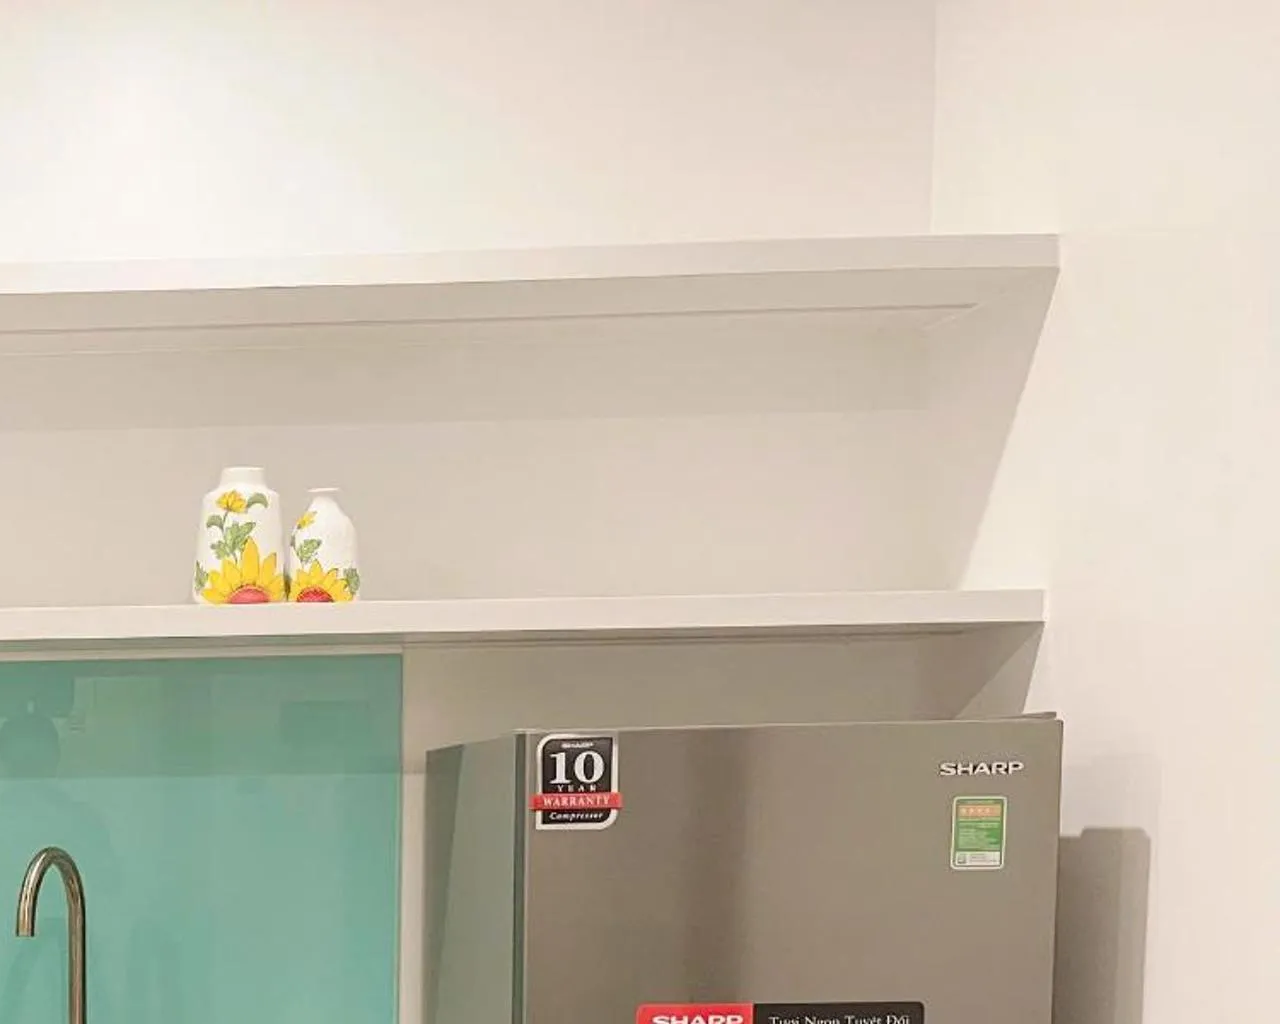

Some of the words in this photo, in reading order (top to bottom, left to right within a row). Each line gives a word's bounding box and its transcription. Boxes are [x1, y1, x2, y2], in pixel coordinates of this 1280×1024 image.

[549, 751, 605, 784] 10
[940, 762, 1024, 775] SHARP
[543, 795, 610, 807] WARRANTY
[549, 812, 603, 822] Compressor
